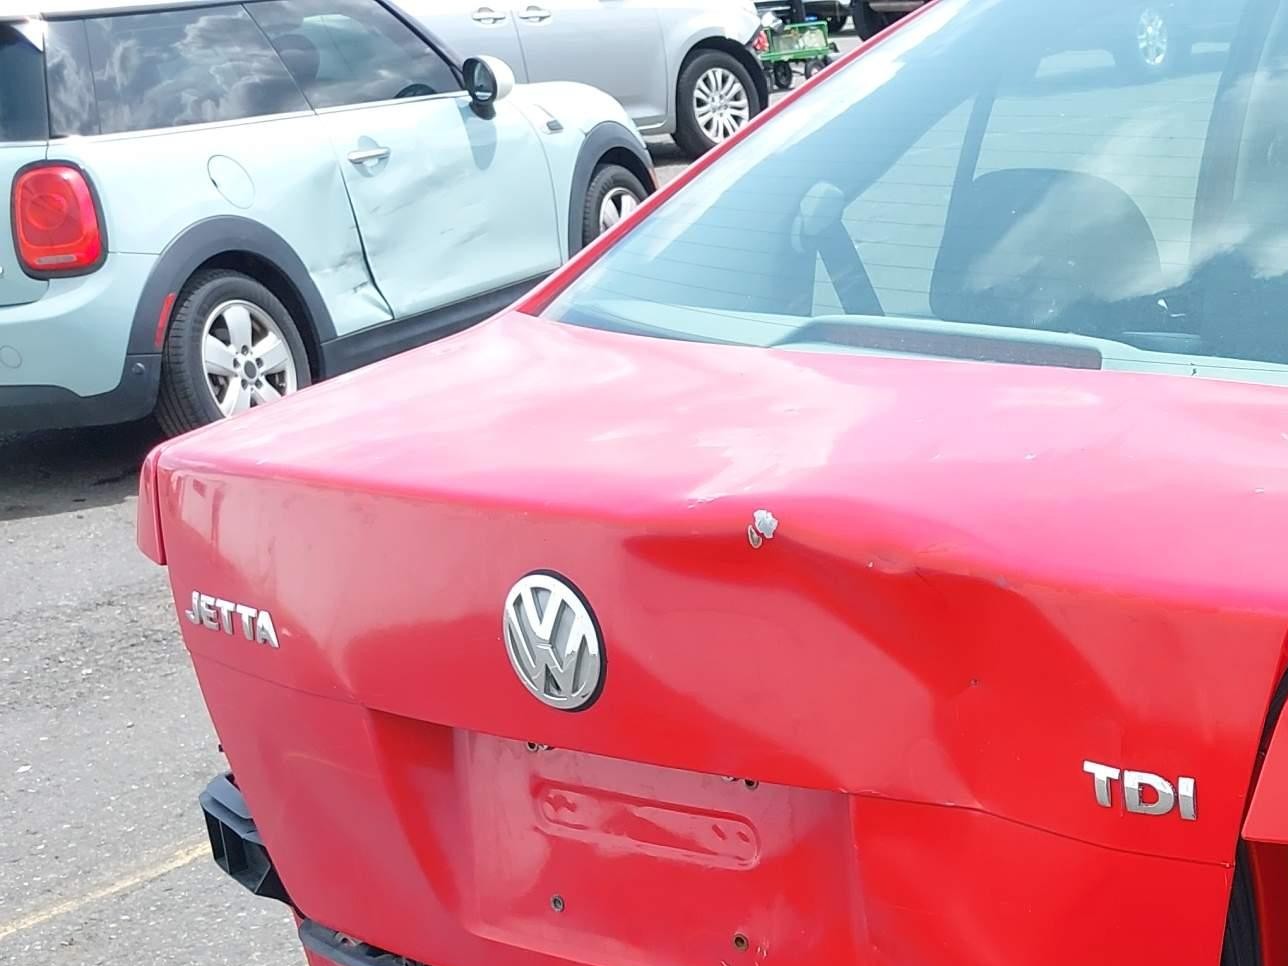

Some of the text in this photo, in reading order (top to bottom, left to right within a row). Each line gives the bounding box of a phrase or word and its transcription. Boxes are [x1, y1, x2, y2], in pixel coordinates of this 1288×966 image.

[185, 590, 280, 649] JETTA
[503, 571, 606, 711] VW
[1083, 760, 1197, 821] TDI
